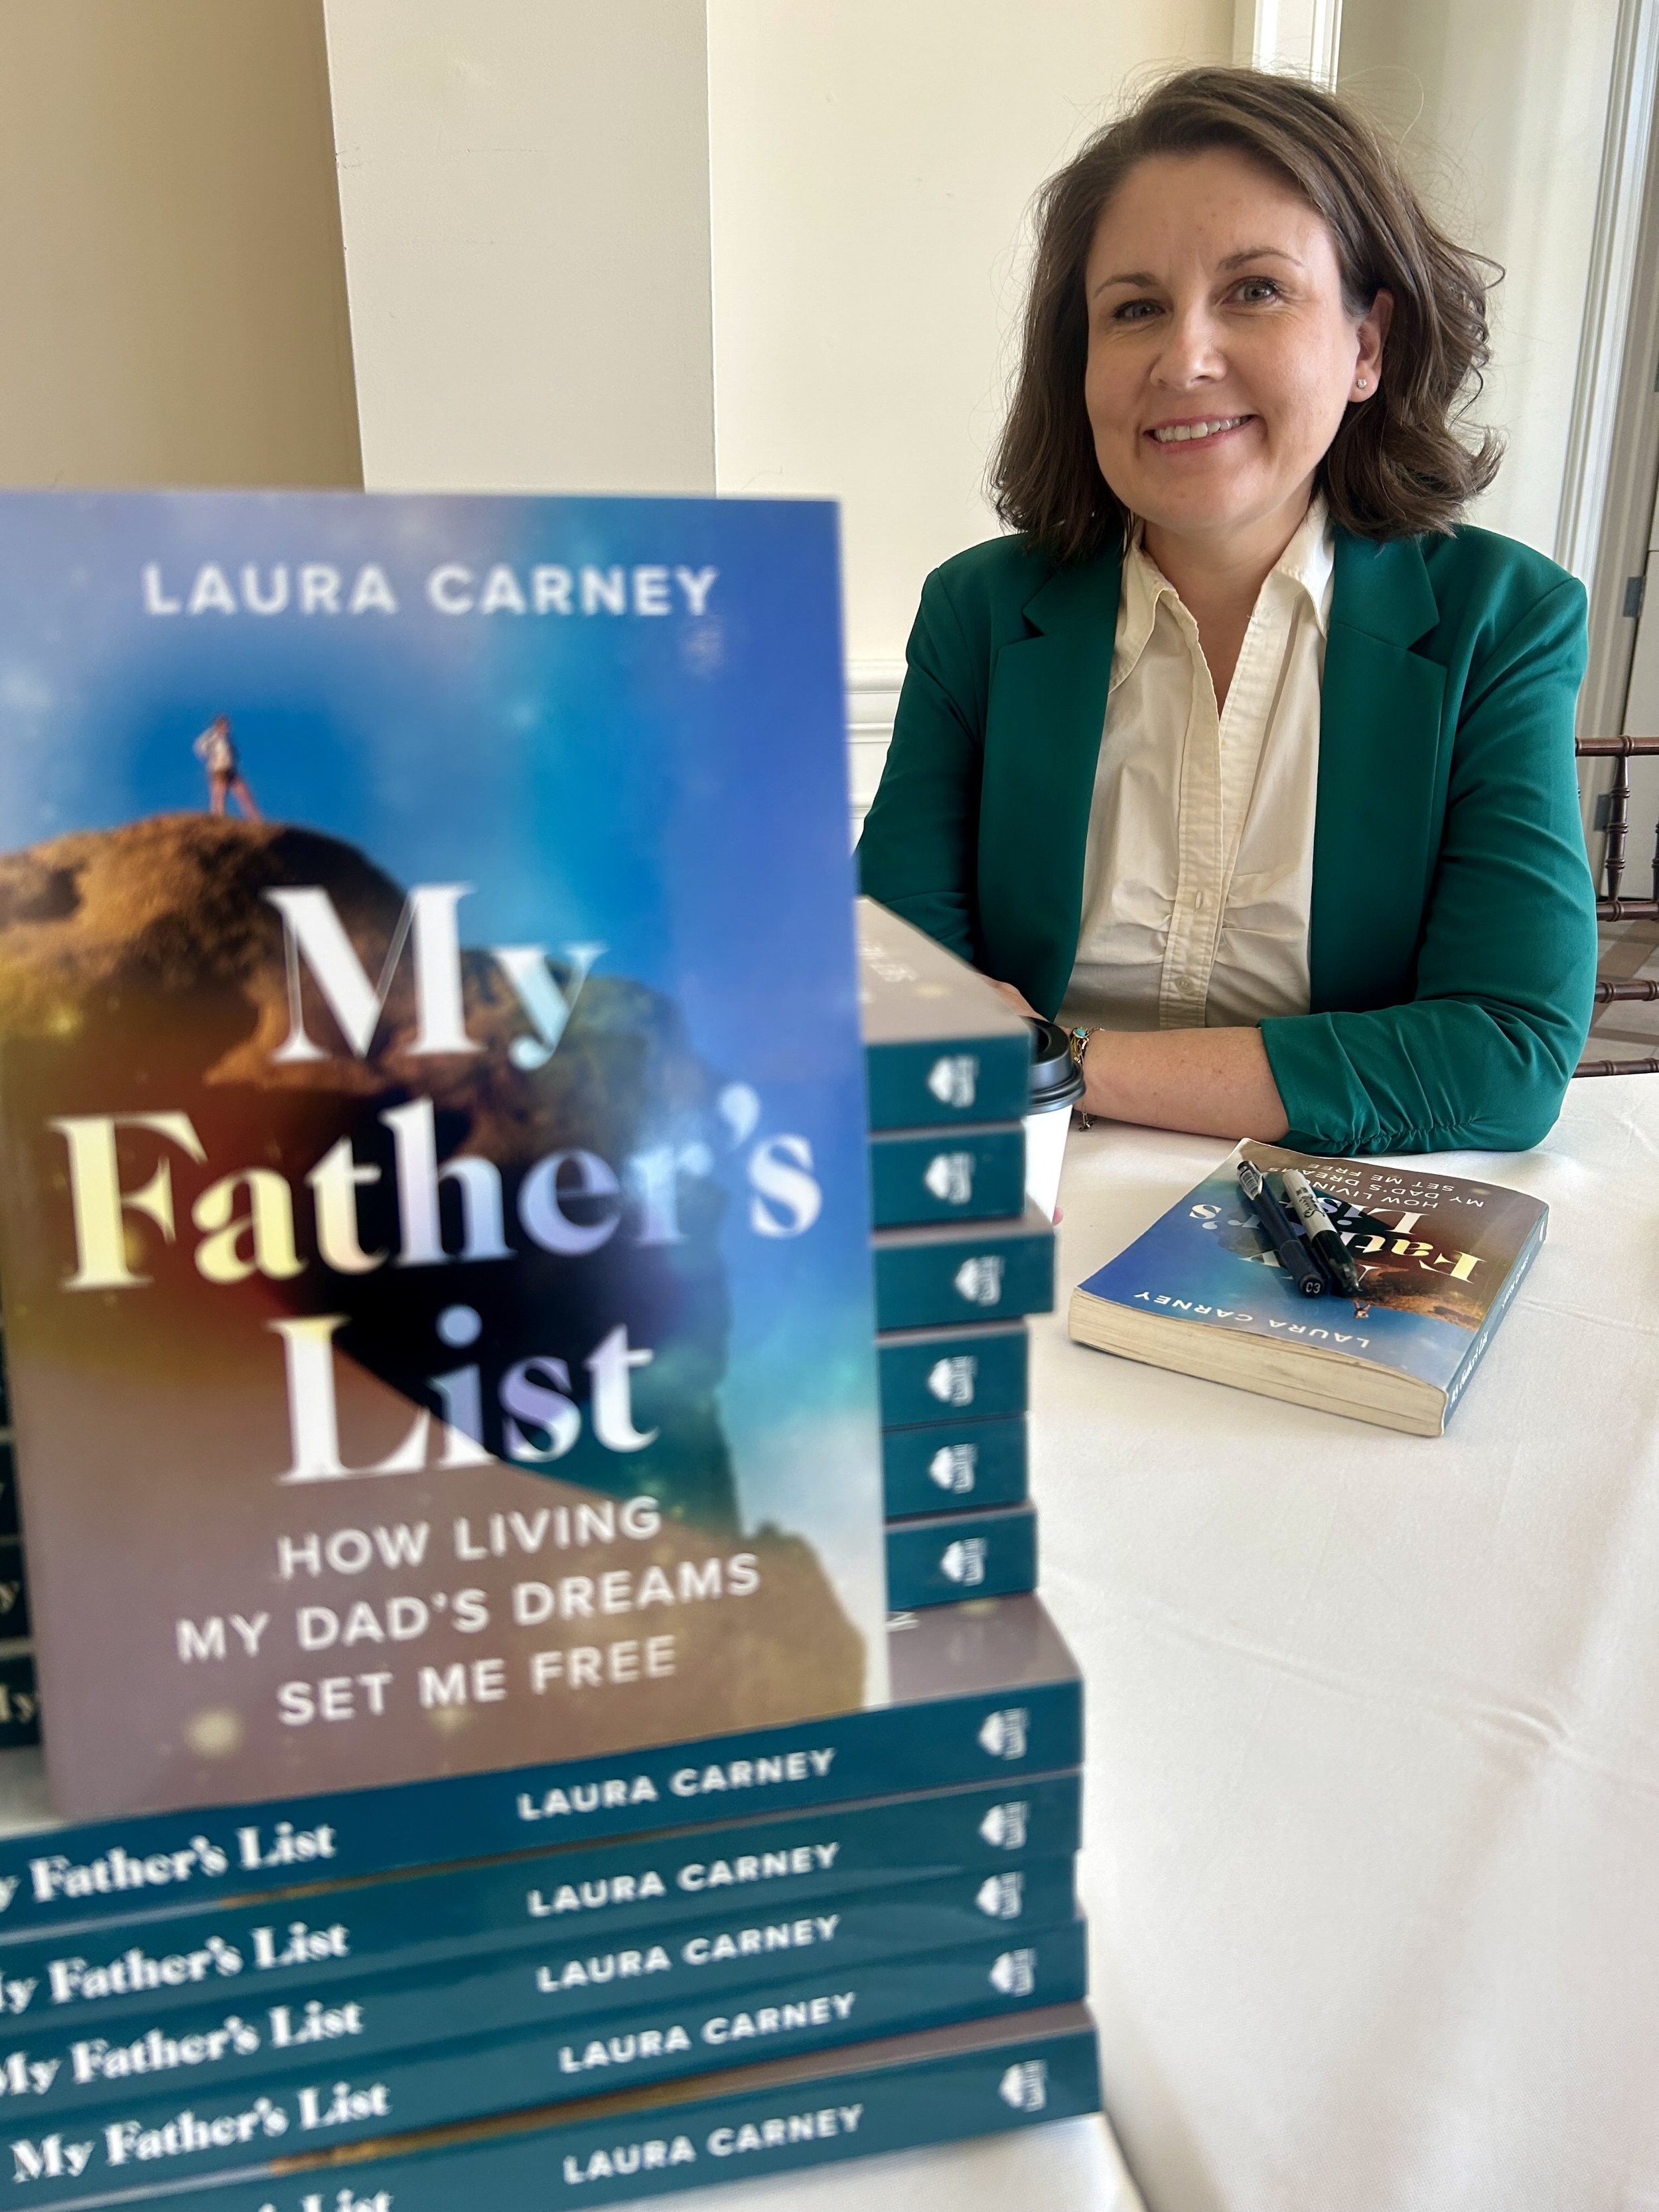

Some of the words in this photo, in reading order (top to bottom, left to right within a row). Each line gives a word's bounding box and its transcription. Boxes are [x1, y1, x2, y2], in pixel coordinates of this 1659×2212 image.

[142, 561, 397, 615] LAURA
[427, 563, 719, 616] CARNEY
[260, 882, 610, 1070] My
[46, 1080, 822, 1291] Father's
[1305, 1179, 1378, 1200] LIVIN
[1307, 1163, 1362, 1177] FREE
[1369, 1184, 1439, 1200] DAD'S
[1370, 1174, 1402, 1184] ME
[1382, 1195, 1439, 1209] HOW
[1411, 1181, 1455, 1192] SET
[1450, 1197, 1484, 1208] MY
[1133, 1291, 1254, 1322] CARNEY
[1269, 1319, 1370, 1348] LAURA
[267, 1304, 660, 1485] List
[277, 1522, 430, 1580] HOW
[453, 1495, 662, 1561] LIVING
[176, 1612, 269, 1664] MY
[297, 1587, 490, 1651] DAD'S
[513, 1552, 761, 1626] DREAMS
[277, 1671, 393, 1726] SET
[418, 1659, 507, 1708] ME
[532, 1633, 677, 1694] FREE
[517, 1775, 658, 1821] LAURA
[669, 1747, 835, 1798] CARNEY
[30, 1834, 229, 1903] Father's
[237, 1821, 337, 1871] List
[527, 1870, 665, 1917] LAURA
[678, 1842, 840, 1891] CARNEY
[47, 1935, 243, 2004] Father's
[251, 1921, 350, 1969] List
[536, 1945, 672, 1993] LAURA
[683, 1914, 840, 1966] CARNEY
[71, 2014, 259, 2084] Father's
[269, 1999, 364, 2048] List
[559, 2024, 691, 2074] LAURA
[701, 1992, 856, 2045] CARNEY
[10, 2132, 95, 2183] My
[104, 2097, 289, 2166] Father's
[297, 2081, 392, 2130] List
[563, 2135, 696, 2186] LAURA
[707, 2103, 863, 2158] CARNEY
